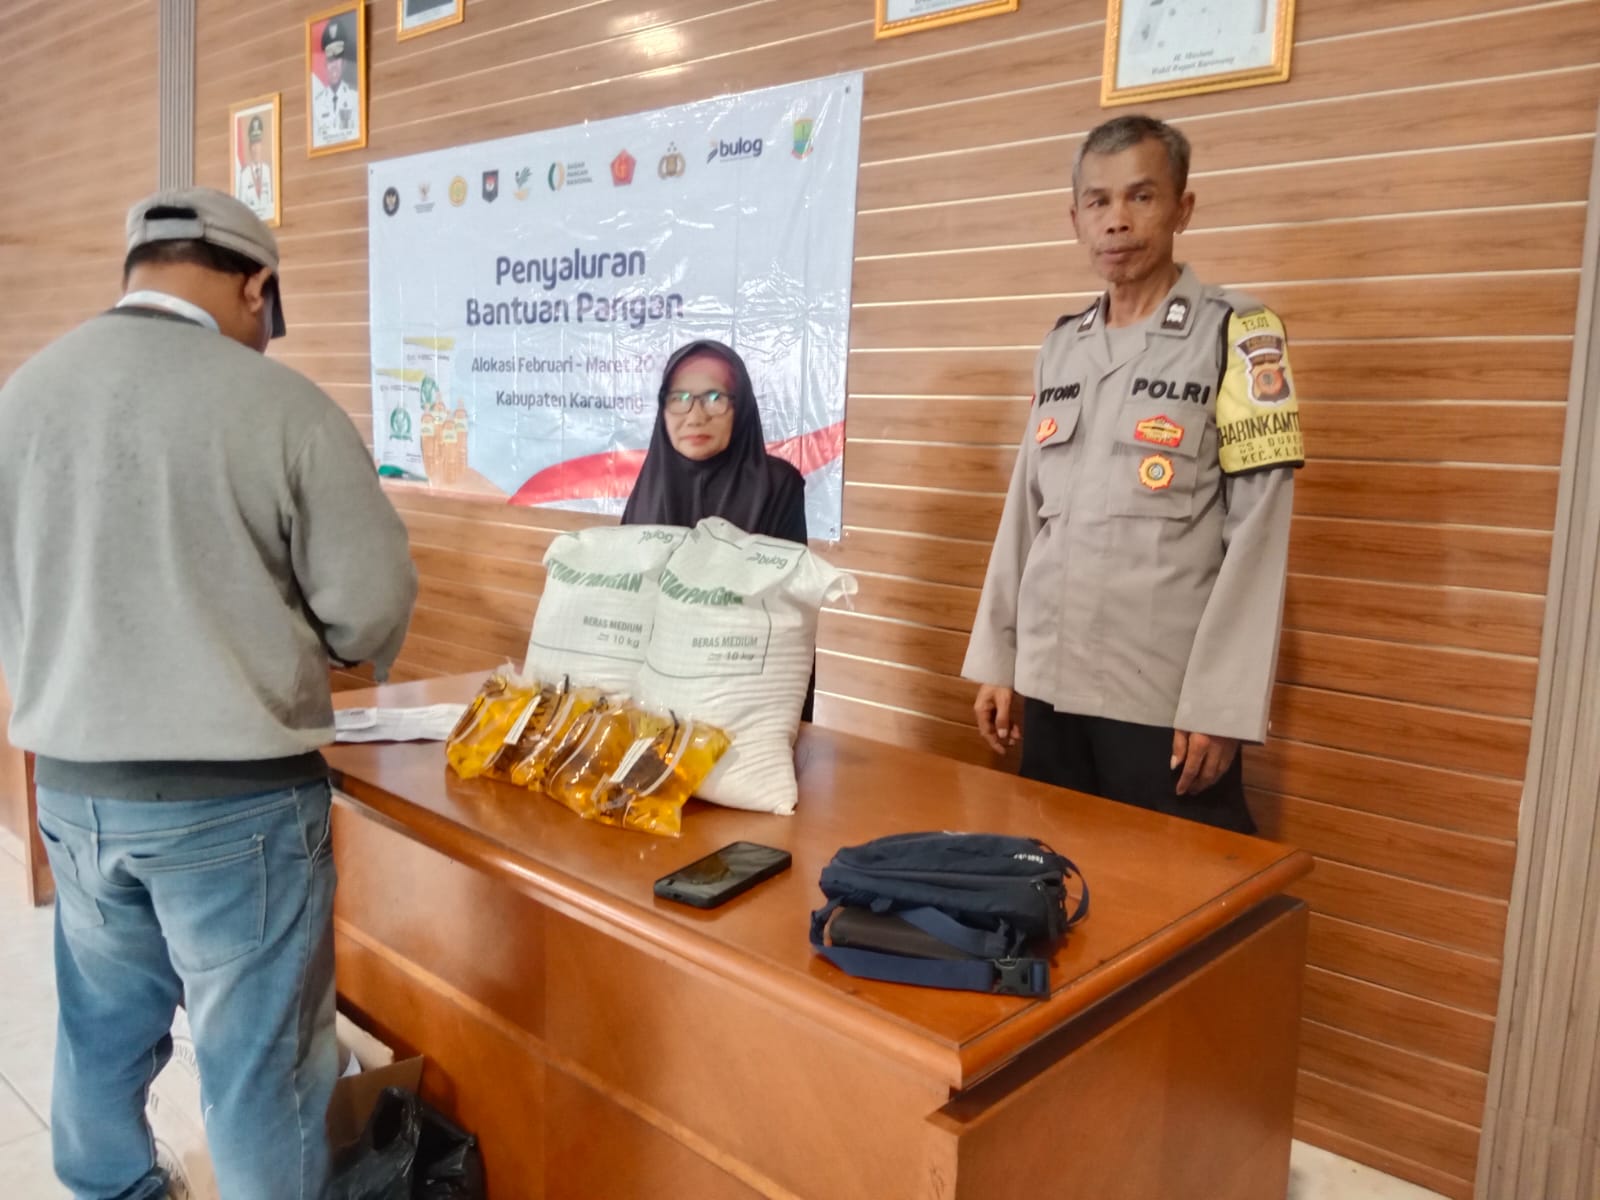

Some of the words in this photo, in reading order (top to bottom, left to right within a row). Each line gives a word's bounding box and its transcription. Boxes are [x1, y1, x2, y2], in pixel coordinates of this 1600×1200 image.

[720, 136, 763, 158] bulog
[495, 248, 647, 291] Penyaluran
[466, 298, 569, 326] Bantuan
[576, 292, 684, 330] Pangan
[471, 356, 516, 373] Alokasi
[518, 356, 573, 373] Februari
[585, 356, 630, 374] Maret
[496, 390, 566, 411] Kabupaten
[569, 392, 645, 414] Karawang
[1132, 378, 1210, 404] POLRI
[1218, 411, 1299, 448] HABINKAMT
[583, 616, 608, 628] BERAS
[609, 622, 643, 633] MEDIUM
[613, 634, 625, 645] 10
[627, 637, 640, 649] kg
[692, 637, 719, 648] BERAS
[721, 636, 757, 648] MEDIUM
